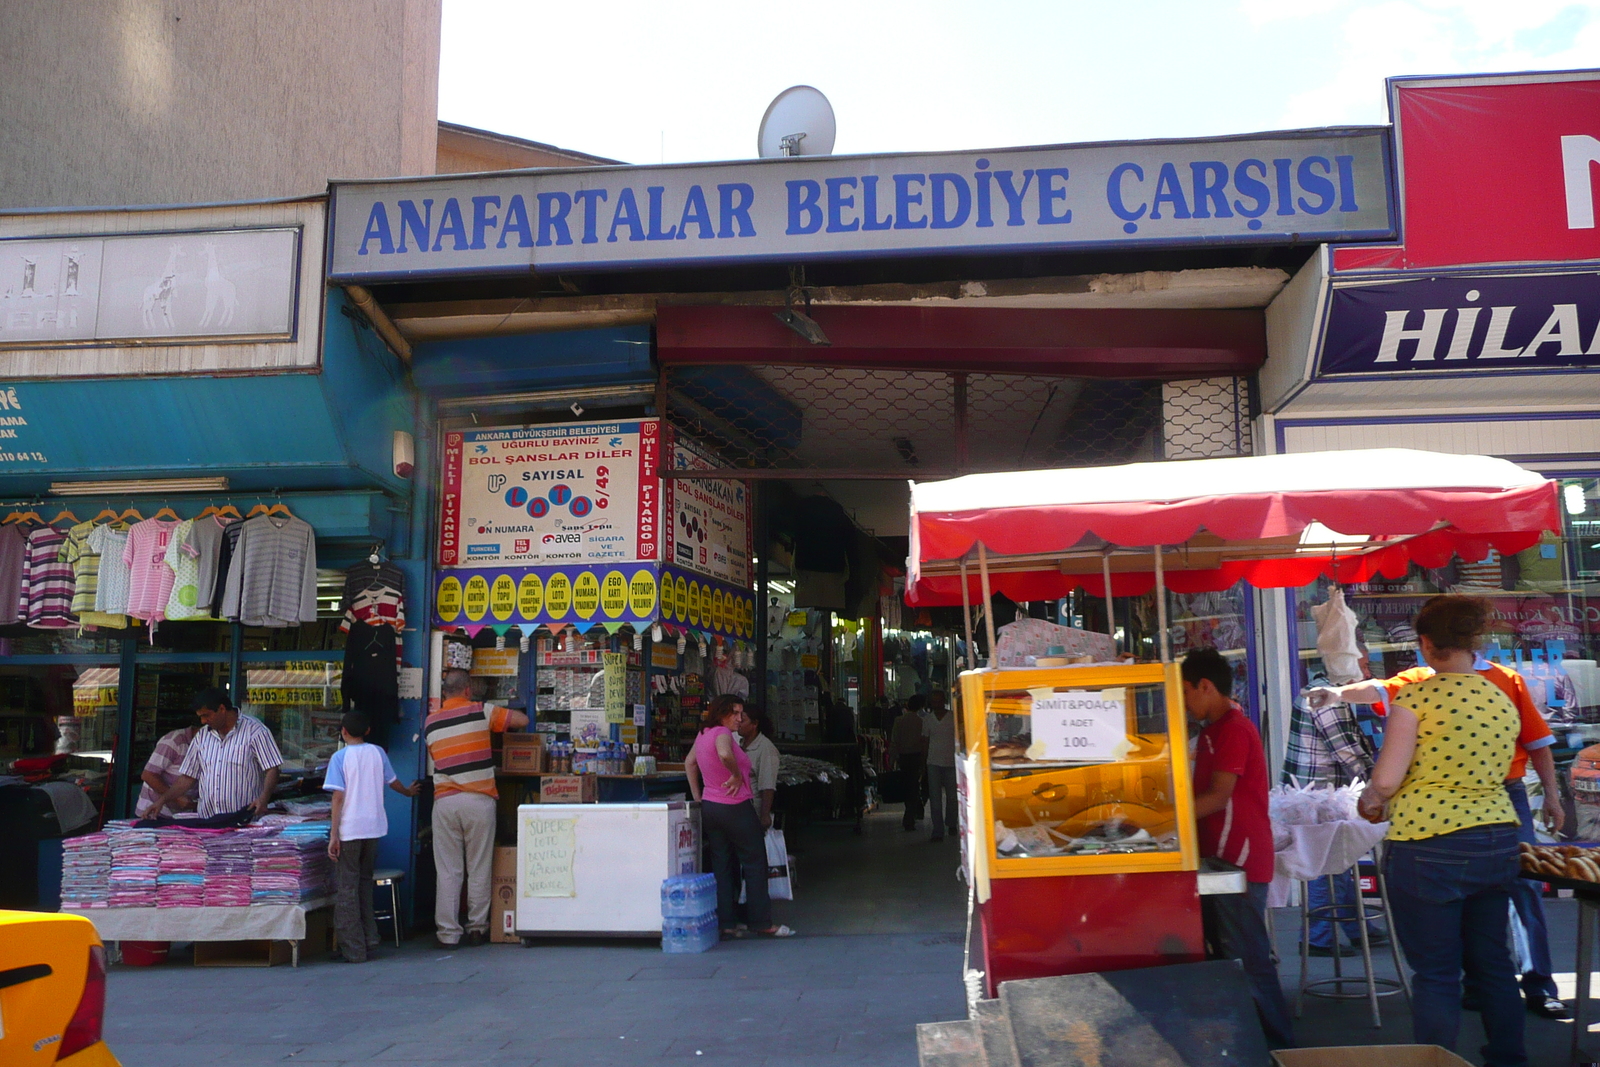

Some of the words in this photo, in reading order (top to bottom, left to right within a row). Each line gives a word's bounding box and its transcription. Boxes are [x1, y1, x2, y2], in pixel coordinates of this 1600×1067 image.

[358, 183, 757, 256] ANAFARTALAR
[785, 158, 1072, 235] BELEDİYE
[1107, 155, 1358, 234] ÇARŞISI
[1374, 289, 1600, 363] HİLA
[475, 432, 511, 441] ANKARA
[512, 427, 567, 440] BÜYÜKŞEHİR
[569, 423, 620, 436] BELEDİYESİ
[501, 438, 549, 450] UĞURLU
[553, 435, 600, 447] BAYİNİZ
[469, 457, 500, 465] BOL
[505, 452, 580, 465] ŞANSLAR
[585, 448, 633, 459] DİLER
[522, 469, 585, 481] SAYISAL
[511, 485, 589, 518] LOTO
[443, 493, 456, 547] PİYANGO
[641, 485, 653, 540] PİYANGO
[495, 524, 535, 534] NUMARA
[555, 533, 581, 544] avea
[608, 577, 622, 587] EGO
[1061, 719, 1068, 727] 4
[1070, 719, 1094, 727] ADET
